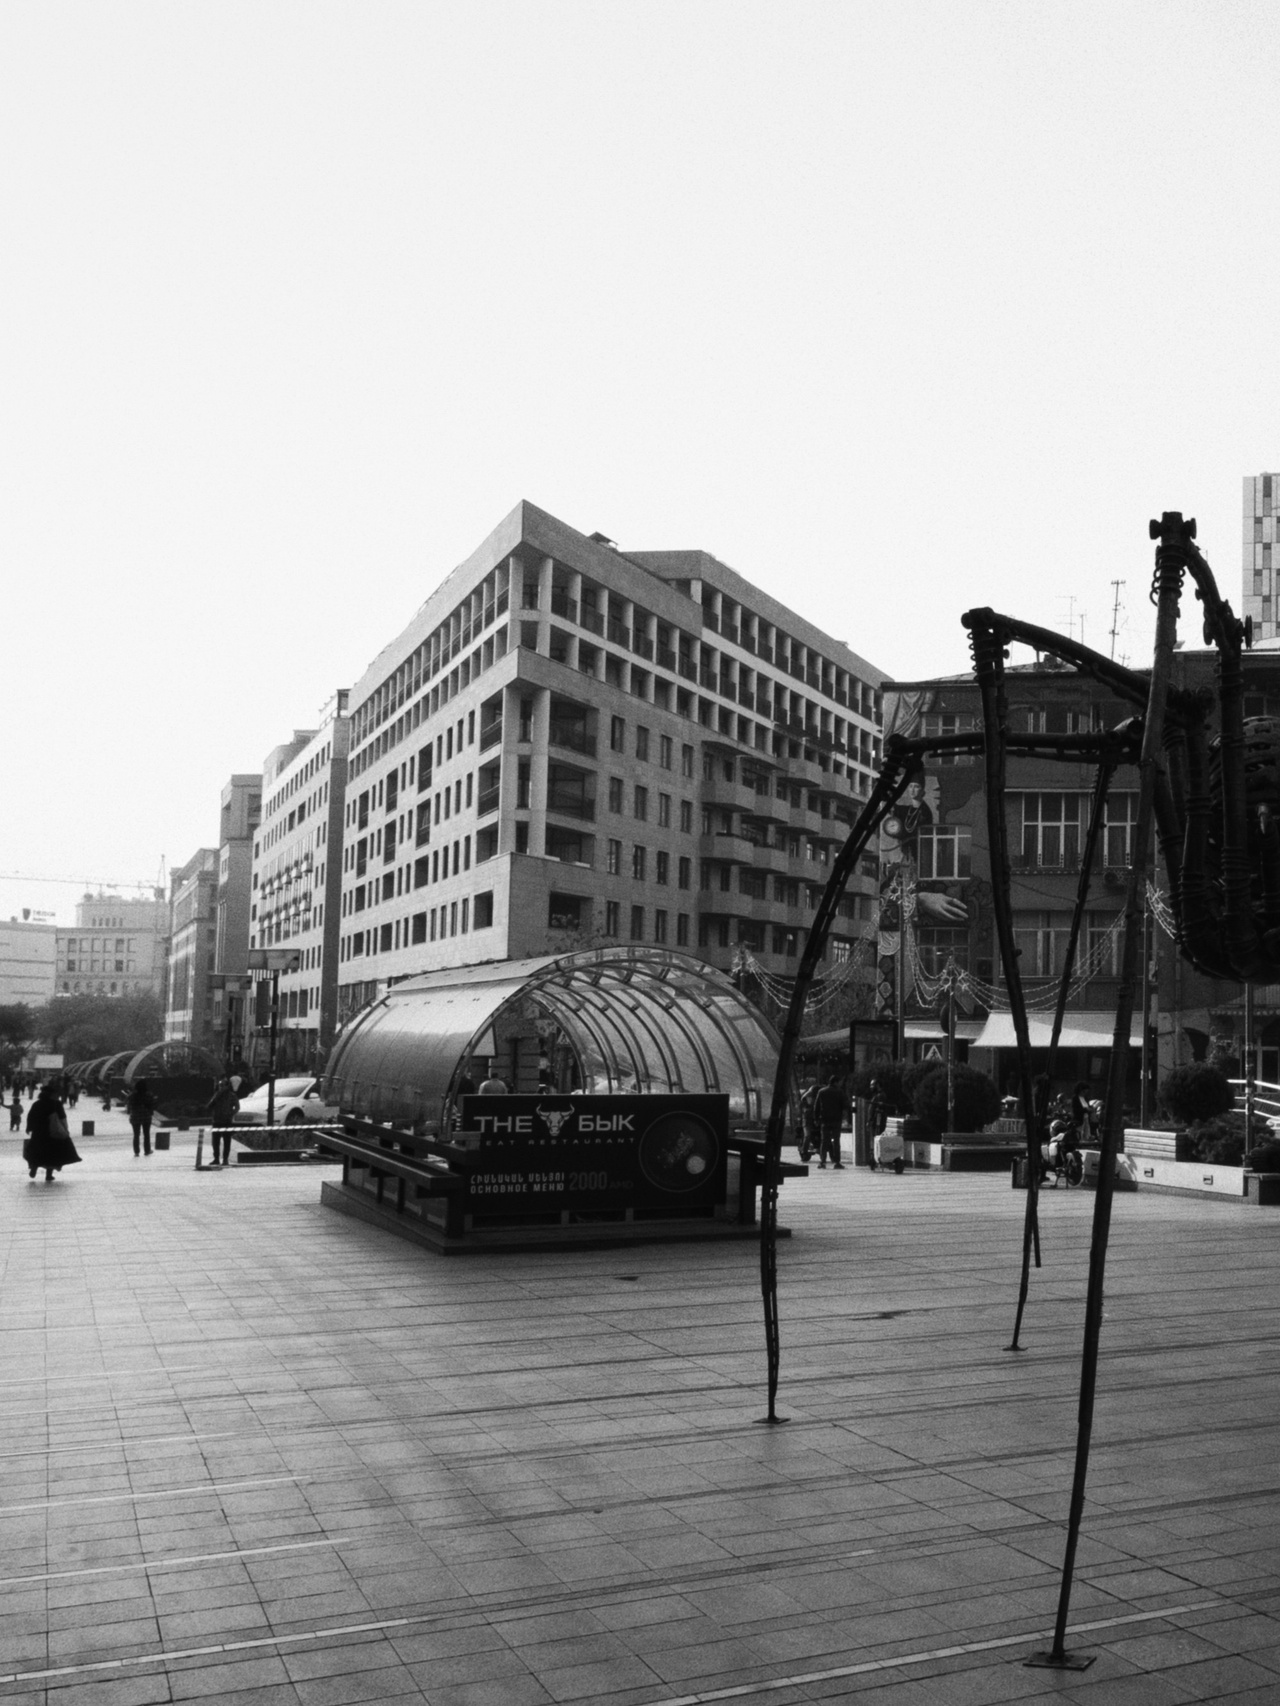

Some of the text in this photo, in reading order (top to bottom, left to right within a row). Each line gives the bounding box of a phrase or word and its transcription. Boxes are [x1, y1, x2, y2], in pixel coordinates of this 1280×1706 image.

[473, 1114, 636, 1133] THE БЫК
[528, 1137, 635, 1146] RESTAURANT
[470, 1182, 565, 1194] ОСНОВНОЕ МЕНЮ
[569, 1171, 608, 1190] 2000
